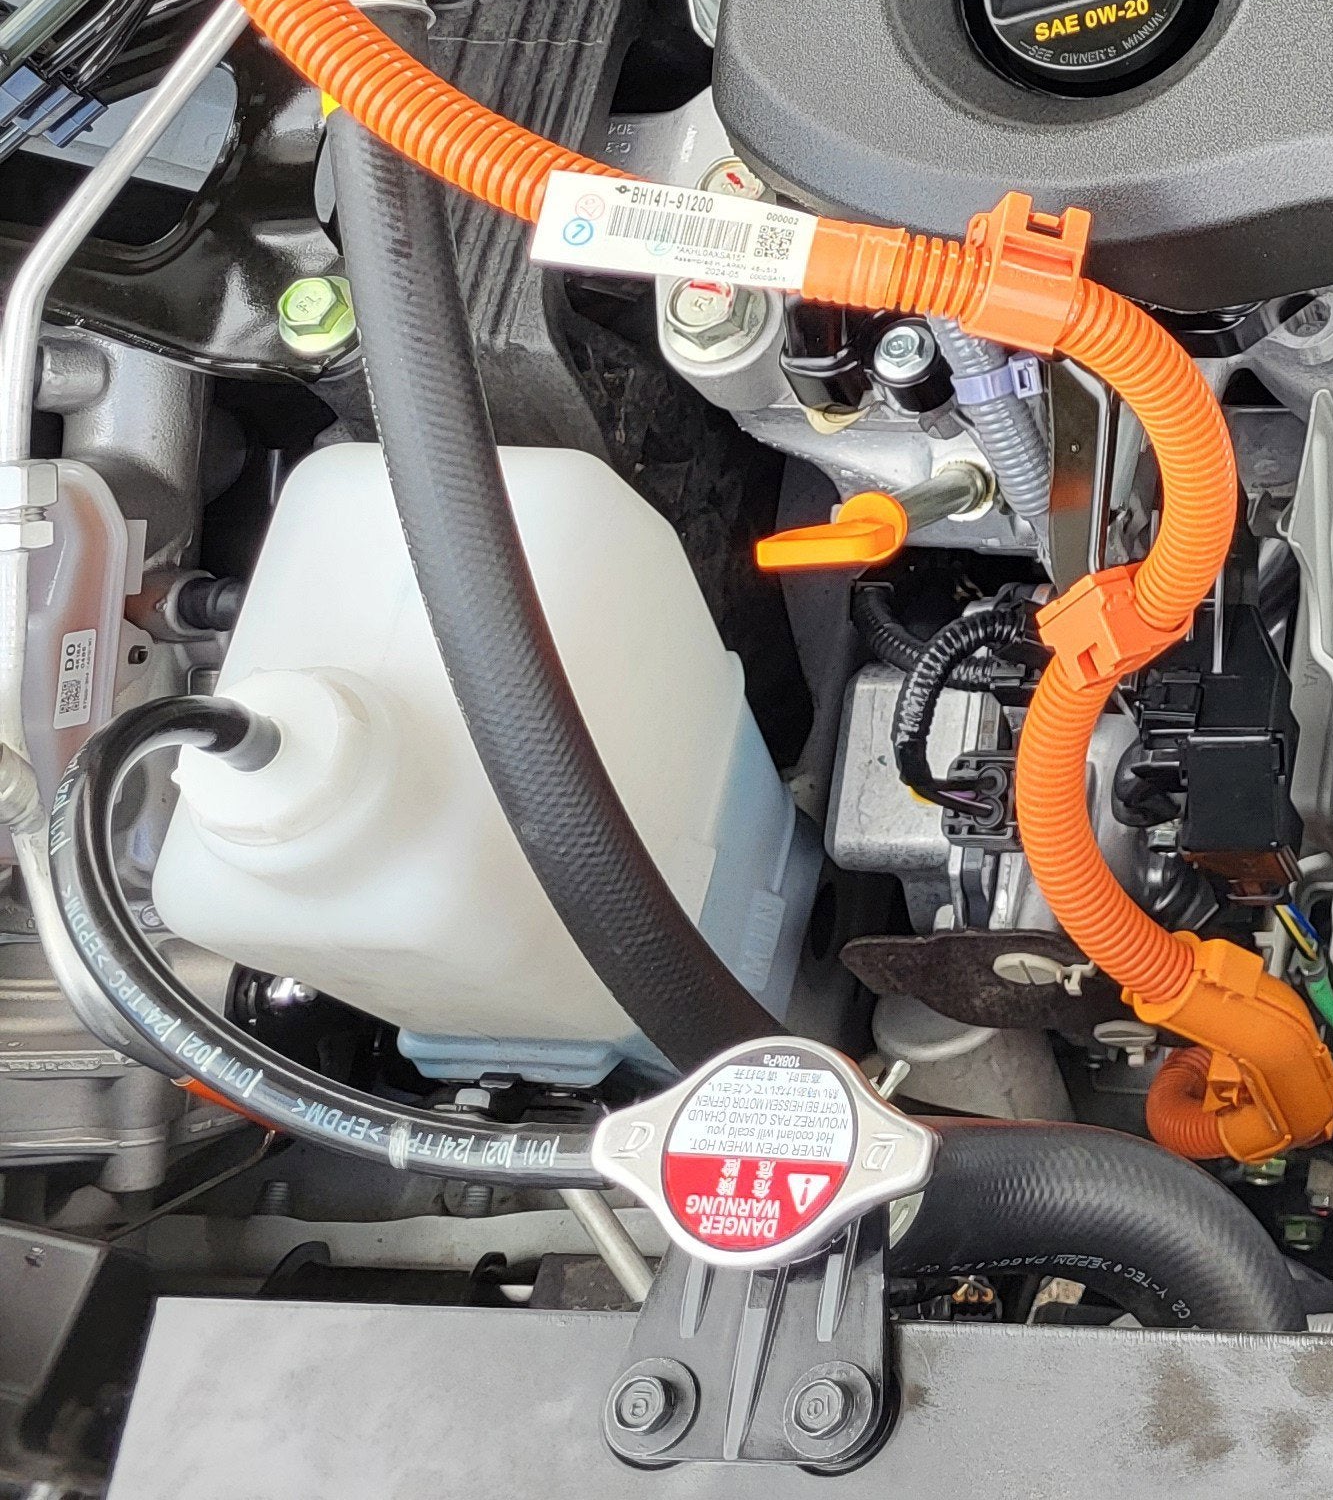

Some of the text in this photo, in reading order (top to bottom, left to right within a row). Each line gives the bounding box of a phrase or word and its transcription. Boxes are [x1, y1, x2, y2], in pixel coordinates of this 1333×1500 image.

[1034, 14, 1081, 43] SAE
[1028, 44, 1055, 63] SEE
[1058, 44, 1118, 66] OWNER'S
[630, 186, 715, 214] BH141-91200
[766, 211, 800, 226] 000002
[109, 969, 148, 1021] TPC
[763, 1053, 803, 1068] 108kPa
[732, 1097, 766, 1111] MOTOR
[765, 1098, 804, 1113] HEISSEM
[804, 1100, 820, 1113] BEI
[820, 1101, 848, 1115] NICHT
[687, 1108, 849, 1130] N'OUVREZ PAS QUAND CHAUD.
[727, 1126, 757, 1140] scald
[756, 1128, 774, 1141] will
[776, 1128, 815, 1142] coolant
[816, 1130, 835, 1144] Hot
[689, 1137, 833, 1158] NEVER OPEN WHEN HOT.
[685, 1194, 781, 1219] WARNUNG
[697, 1215, 779, 1239] DANGER
